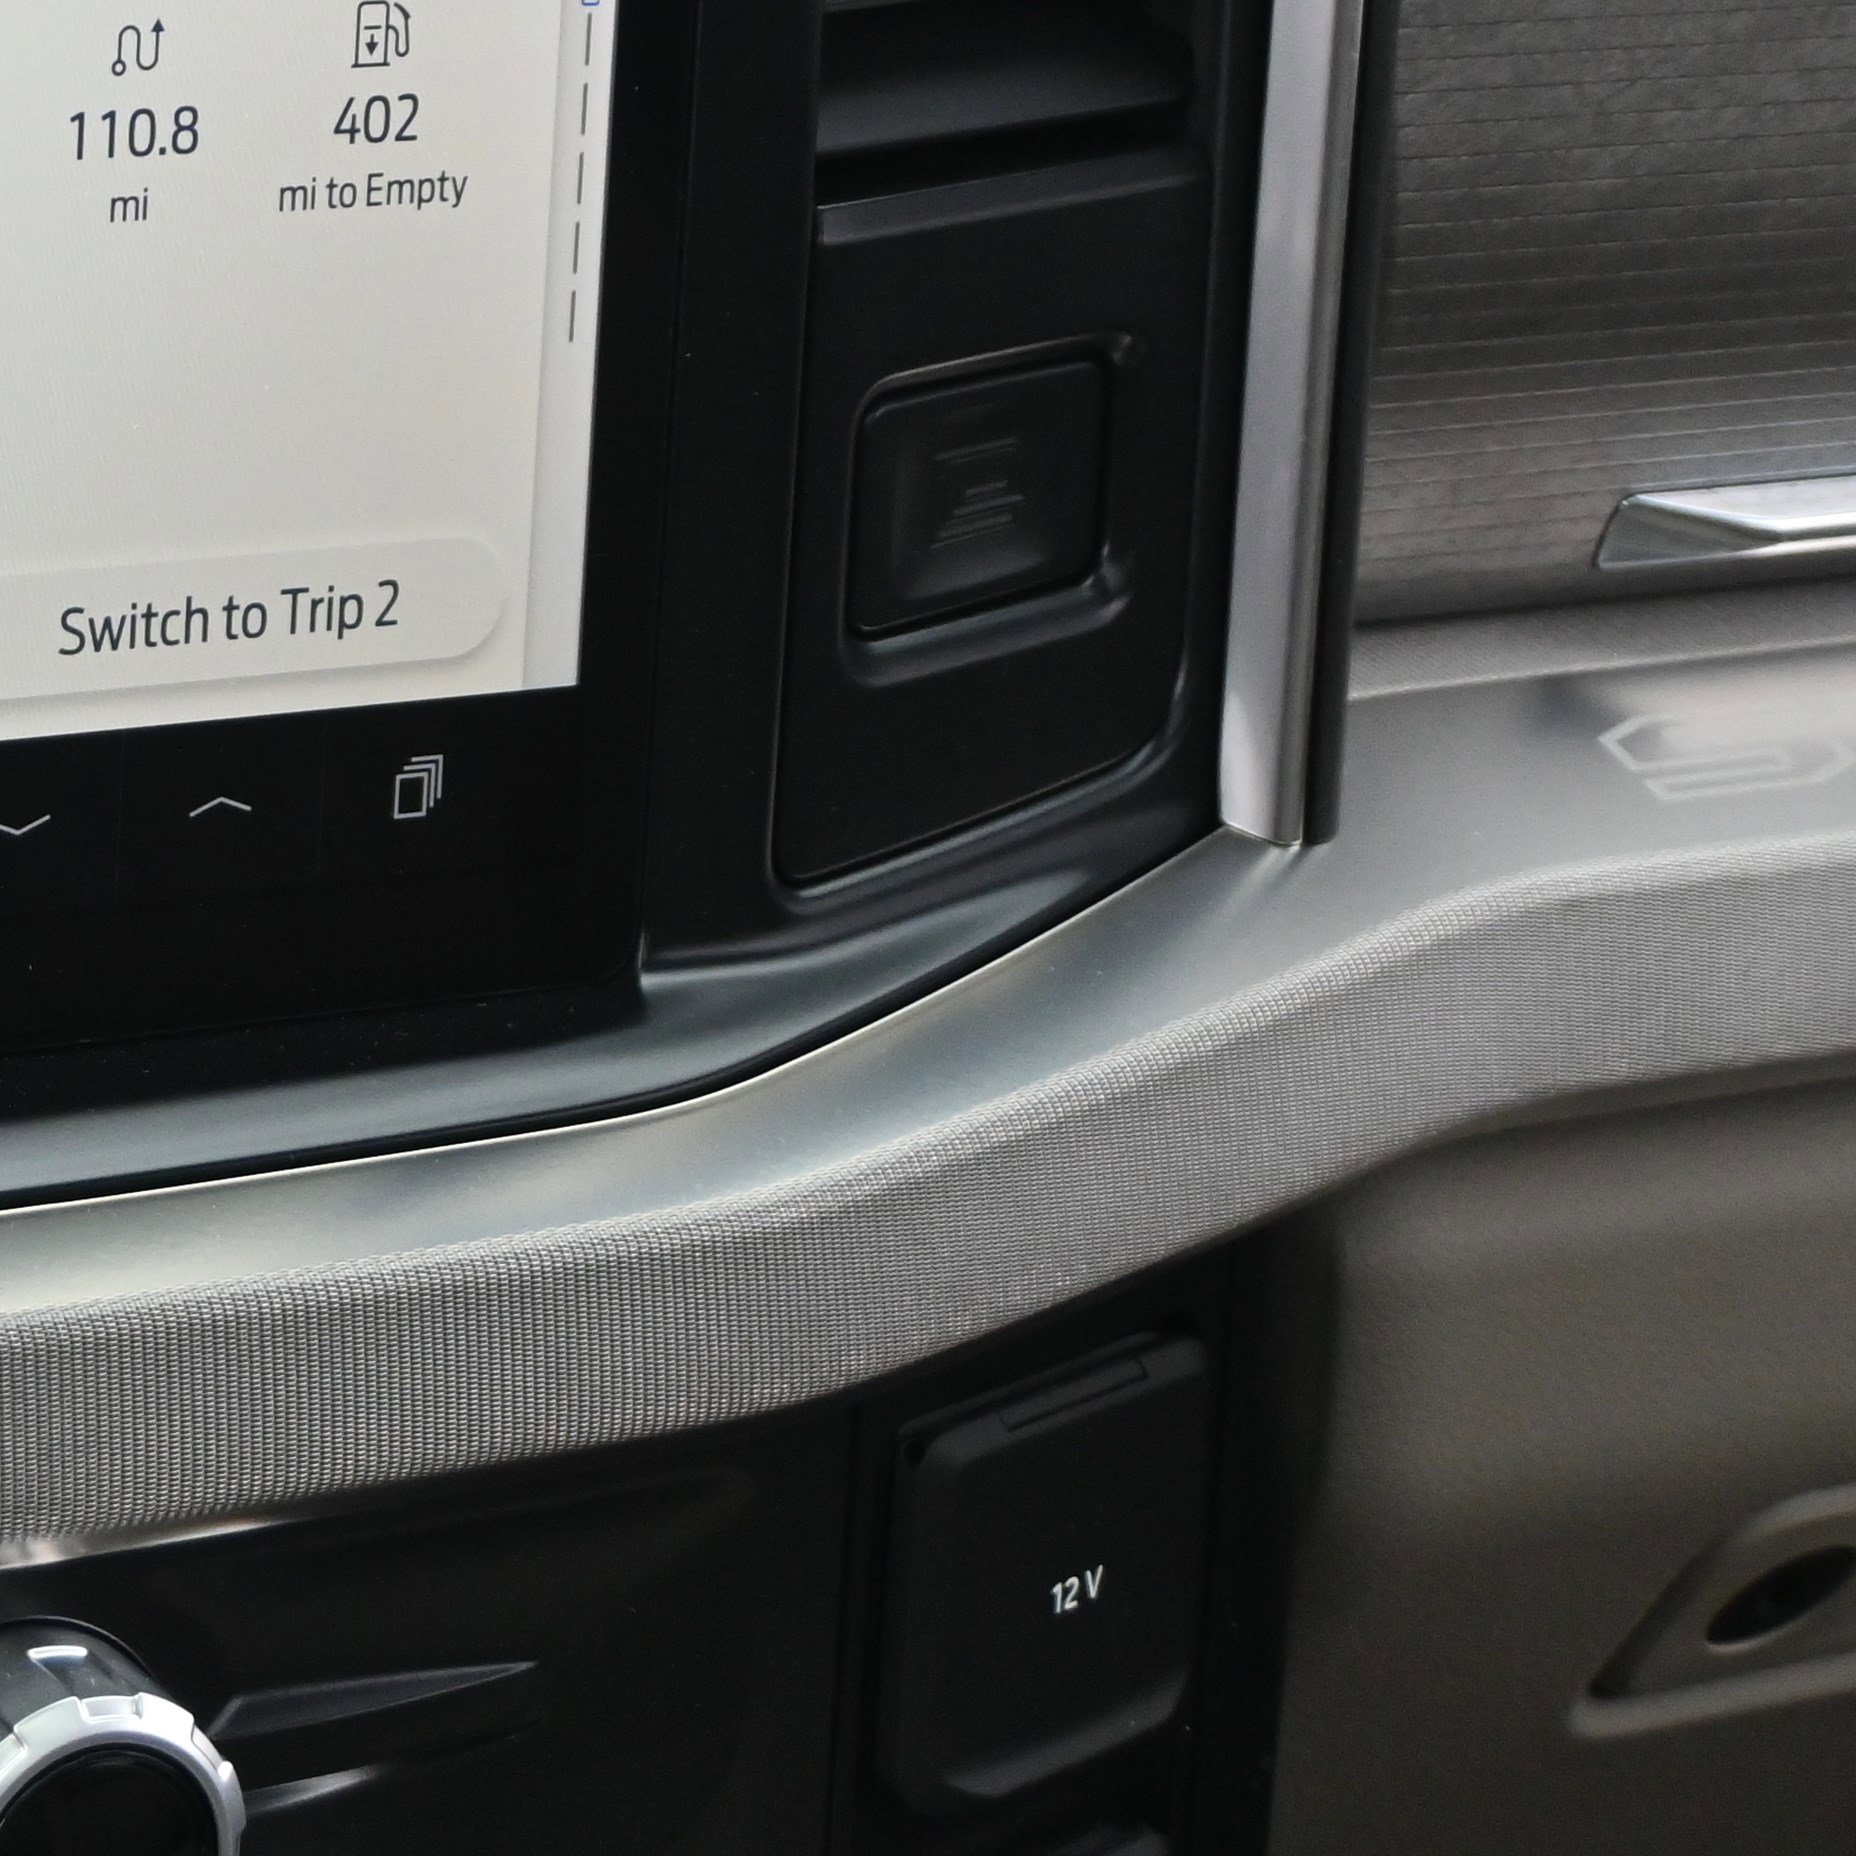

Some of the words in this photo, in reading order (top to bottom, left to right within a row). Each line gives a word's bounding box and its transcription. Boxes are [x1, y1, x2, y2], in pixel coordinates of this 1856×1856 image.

[70, 105, 199, 160] 110.8
[333, 93, 419, 144] 402
[110, 187, 148, 223] mi
[279, 177, 316, 212] mi
[326, 178, 357, 209] to
[366, 171, 468, 210] Empty
[59, 596, 209, 656] Switch
[222, 596, 267, 640] to
[280, 585, 364, 639] Trip
[375, 579, 399, 627] 2
